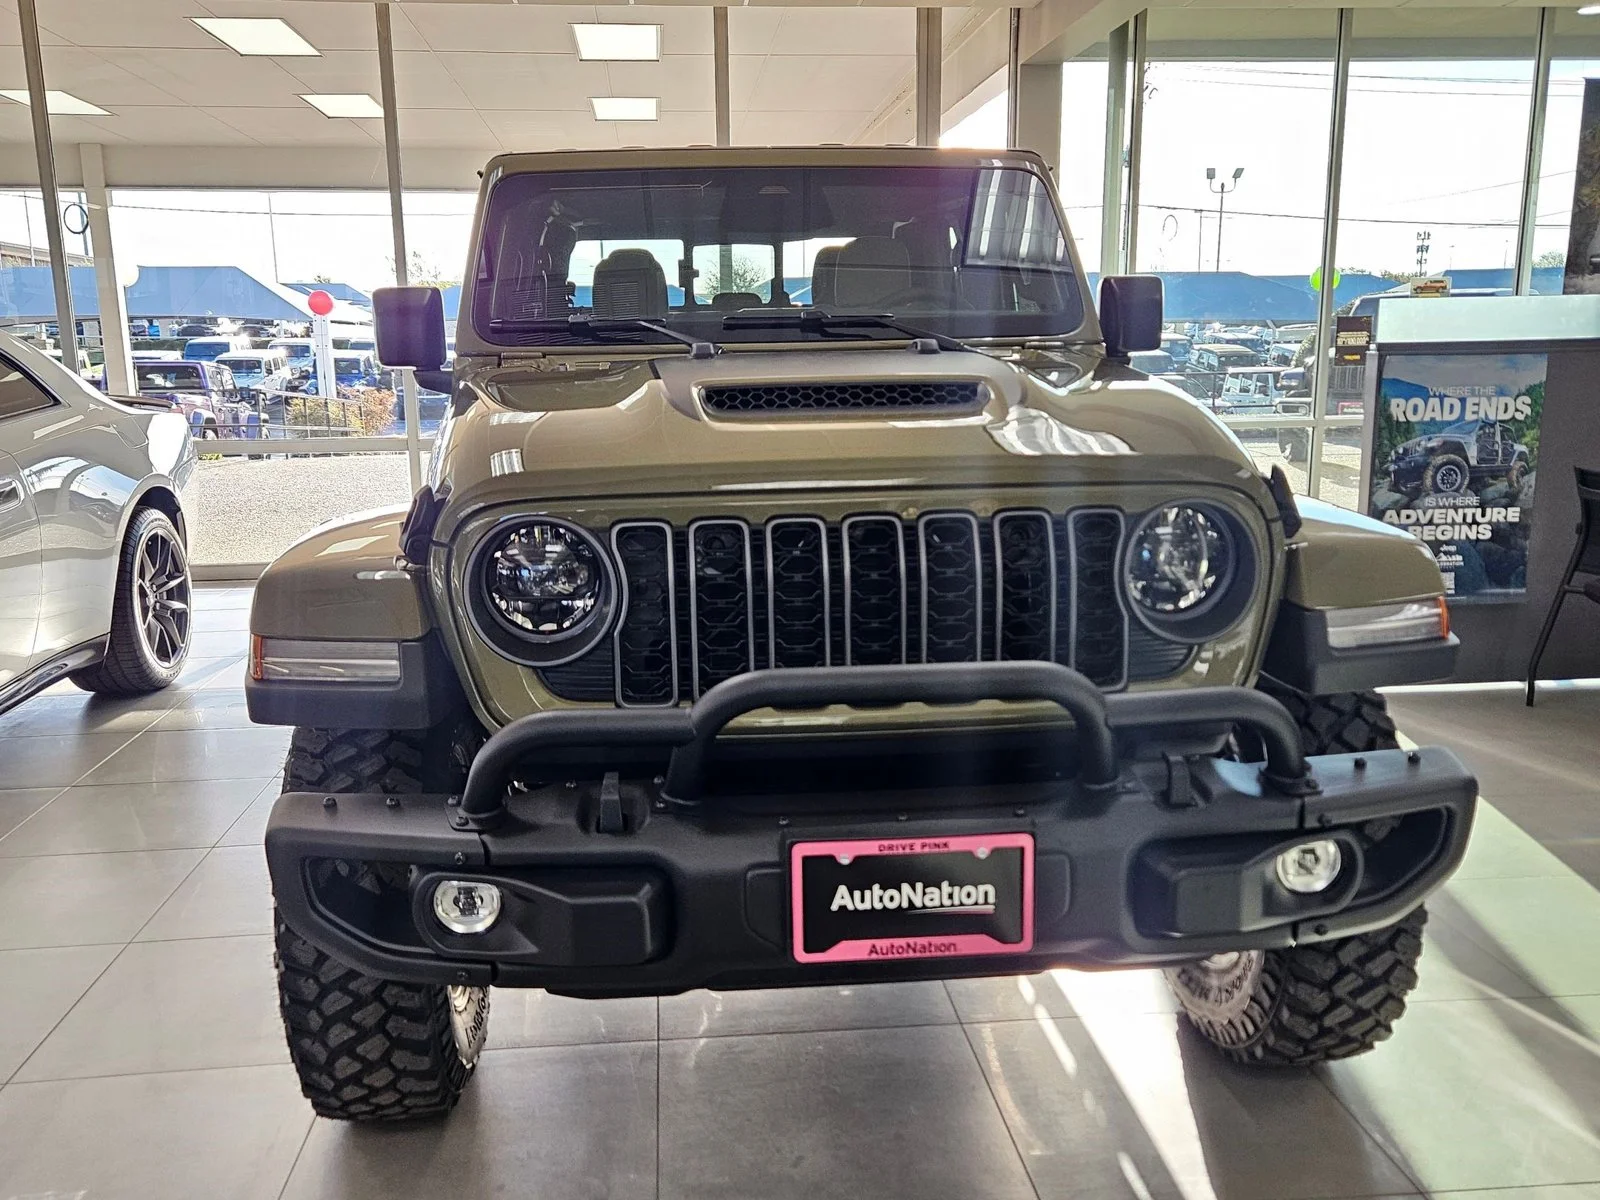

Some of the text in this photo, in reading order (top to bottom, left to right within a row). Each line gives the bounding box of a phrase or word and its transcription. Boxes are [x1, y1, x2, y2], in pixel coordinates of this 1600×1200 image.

[1429, 386, 1496, 396] WHERE THE
[1390, 395, 1532, 422] ROAD ENDS
[1425, 496, 1480, 507] IS WHERE
[1383, 507, 1521, 525] ADVENTURE
[1408, 524, 1493, 540] BEGINS
[878, 841, 950, 852] DRIVE PINK
[829, 880, 997, 912] AutoNation
[867, 941, 958, 957] AutoNation
